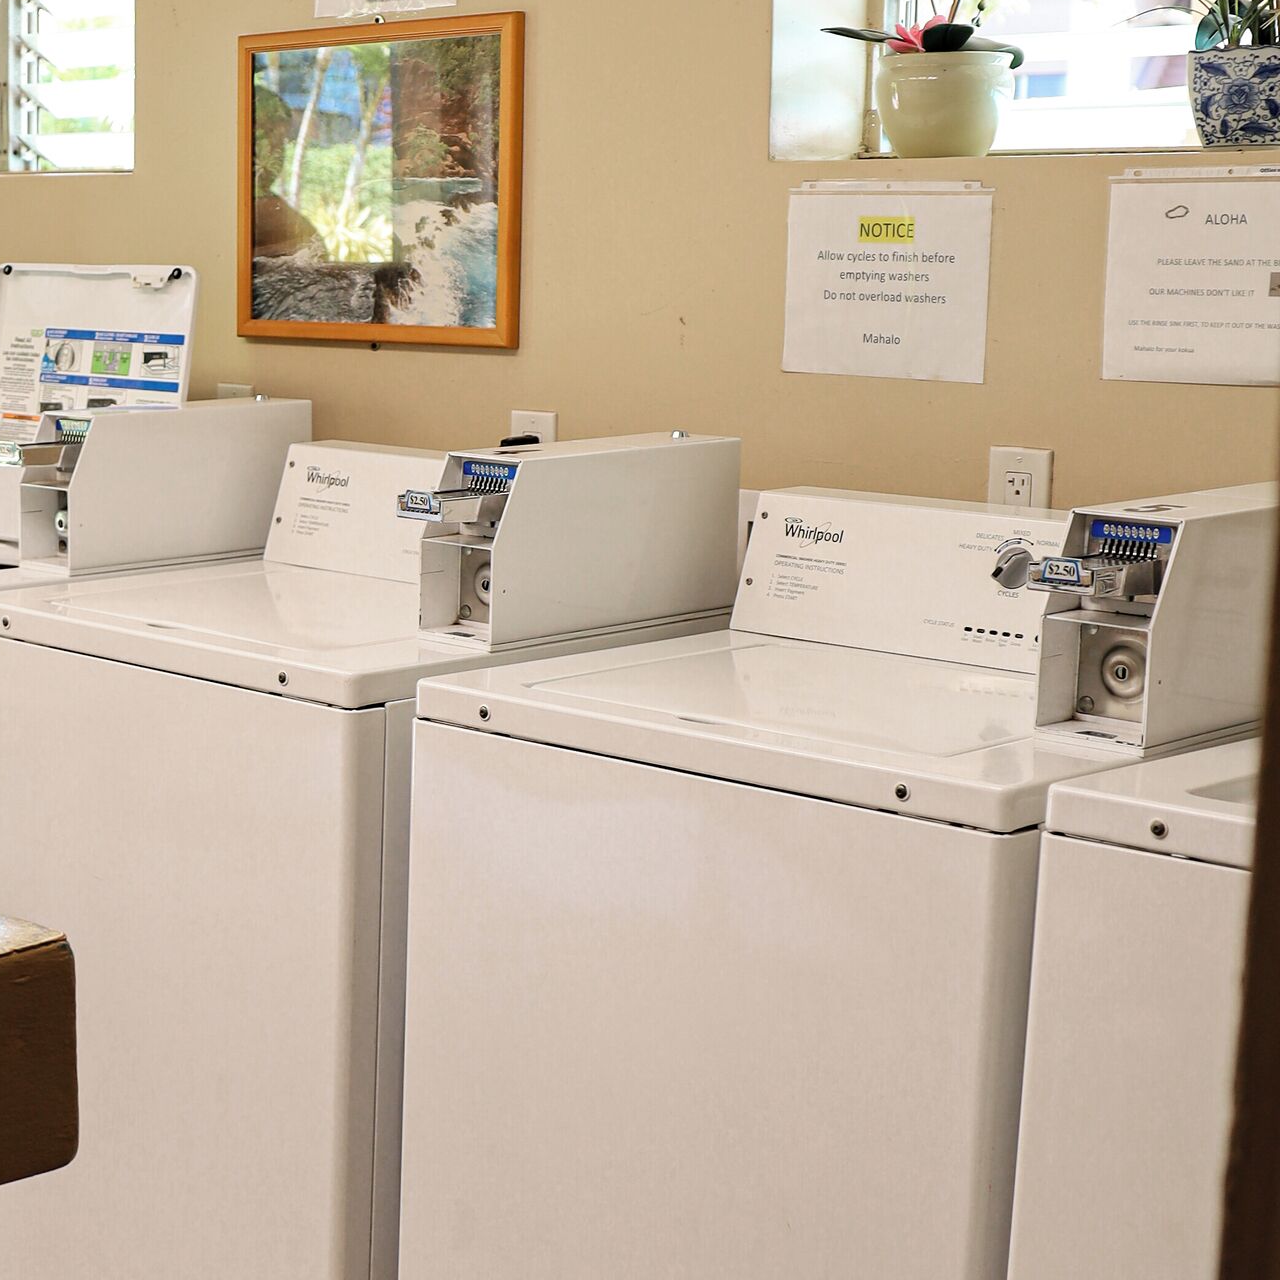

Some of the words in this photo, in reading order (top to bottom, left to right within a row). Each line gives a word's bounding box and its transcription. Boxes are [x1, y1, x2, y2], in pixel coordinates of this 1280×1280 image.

[1205, 213, 1248, 225] ALOHA
[859, 222, 914, 239] NOTICE
[817, 250, 844, 262] Allow
[847, 251, 876, 264] cycles
[879, 252, 890, 262] to
[892, 251, 918, 263] finish
[921, 252, 956, 264] before
[1157, 258, 1182, 266] PLEASE
[1184, 258, 1206, 266] LEAVE
[1208, 258, 1222, 266] THE
[1224, 258, 1244, 266] SAND
[839, 270, 886, 284] emptying
[889, 270, 930, 283] washers
[823, 289, 837, 301] Do
[839, 290, 856, 301] not
[858, 291, 902, 303] overload
[905, 292, 947, 305] washers
[1149, 287, 1164, 296] OUR
[1167, 288, 1205, 296] MACHINES
[863, 333, 901, 345] Mahalo
[307, 471, 350, 488] Whirlpool
[410, 494, 428, 506] $2.50
[785, 523, 844, 544] Whirlpool
[959, 543, 977, 551] HEAVY
[774, 560, 804, 569] OPERATING
[805, 564, 845, 575] INSTRUCTIONS
[1048, 564, 1075, 577] $2.50
[997, 589, 1020, 598] CYCLES
